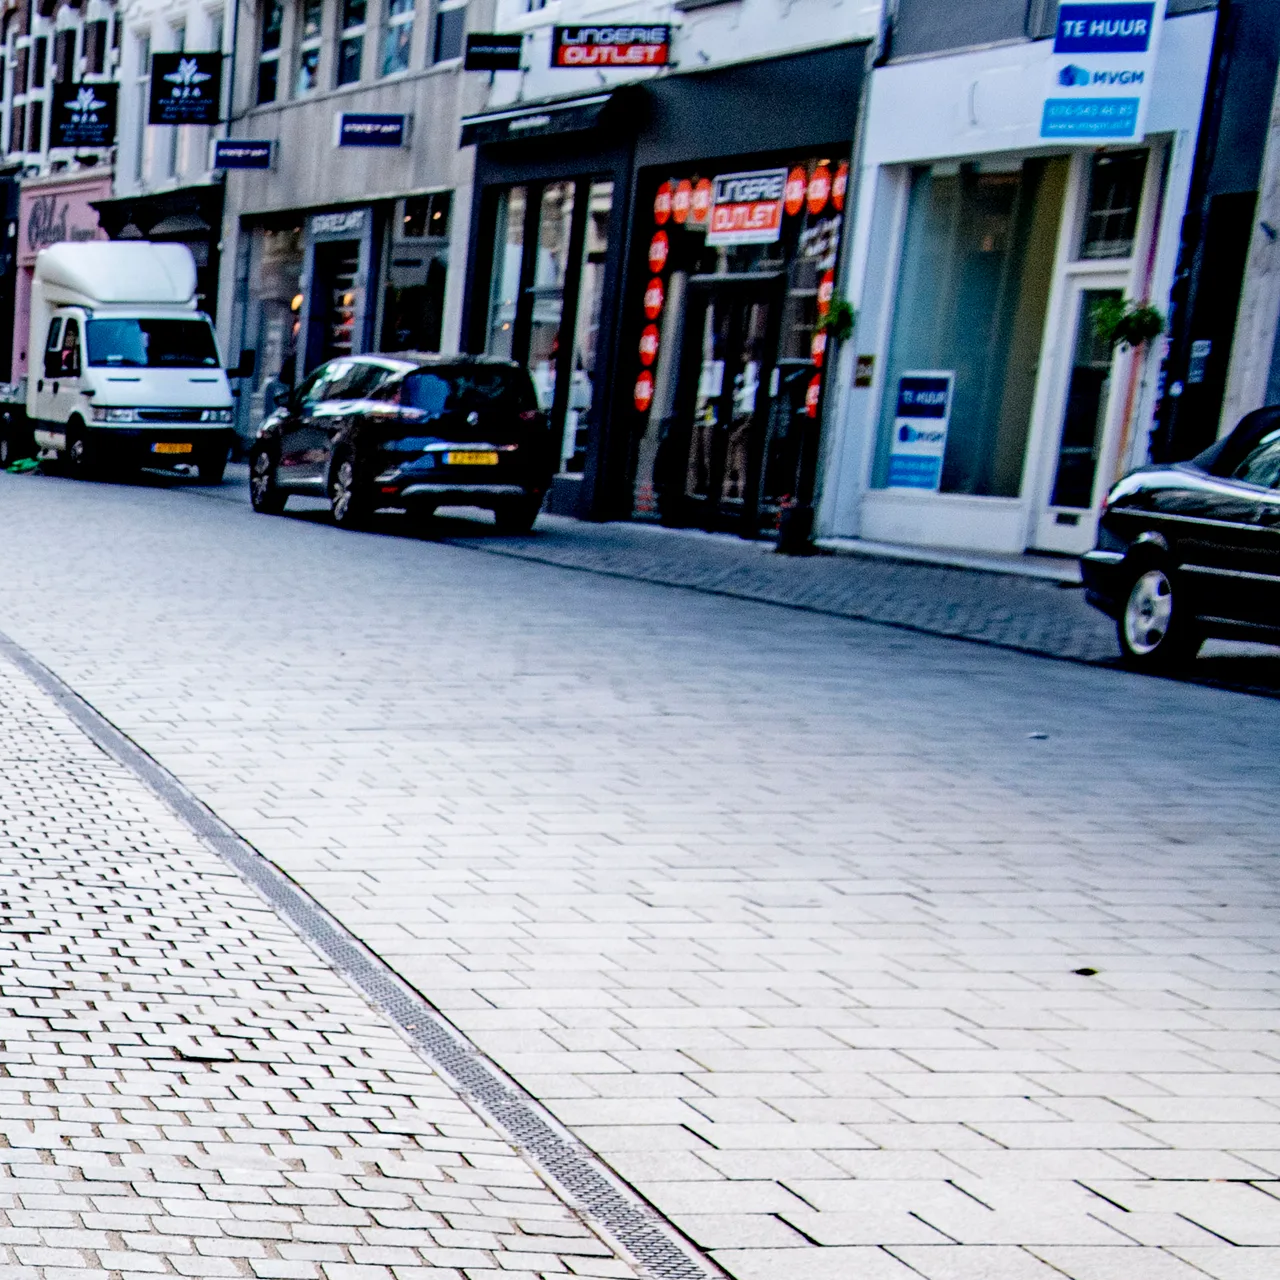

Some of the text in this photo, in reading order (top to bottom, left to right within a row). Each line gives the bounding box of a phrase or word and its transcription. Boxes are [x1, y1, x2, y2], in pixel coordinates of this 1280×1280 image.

[561, 27, 666, 45] LINGERIE
[1063, 19, 1148, 37] TE HUUR
[563, 45, 662, 64] OUTLET
[1093, 70, 1144, 85] MVGM
[716, 174, 785, 202] LINGERIE
[714, 202, 777, 229] OUTLET
